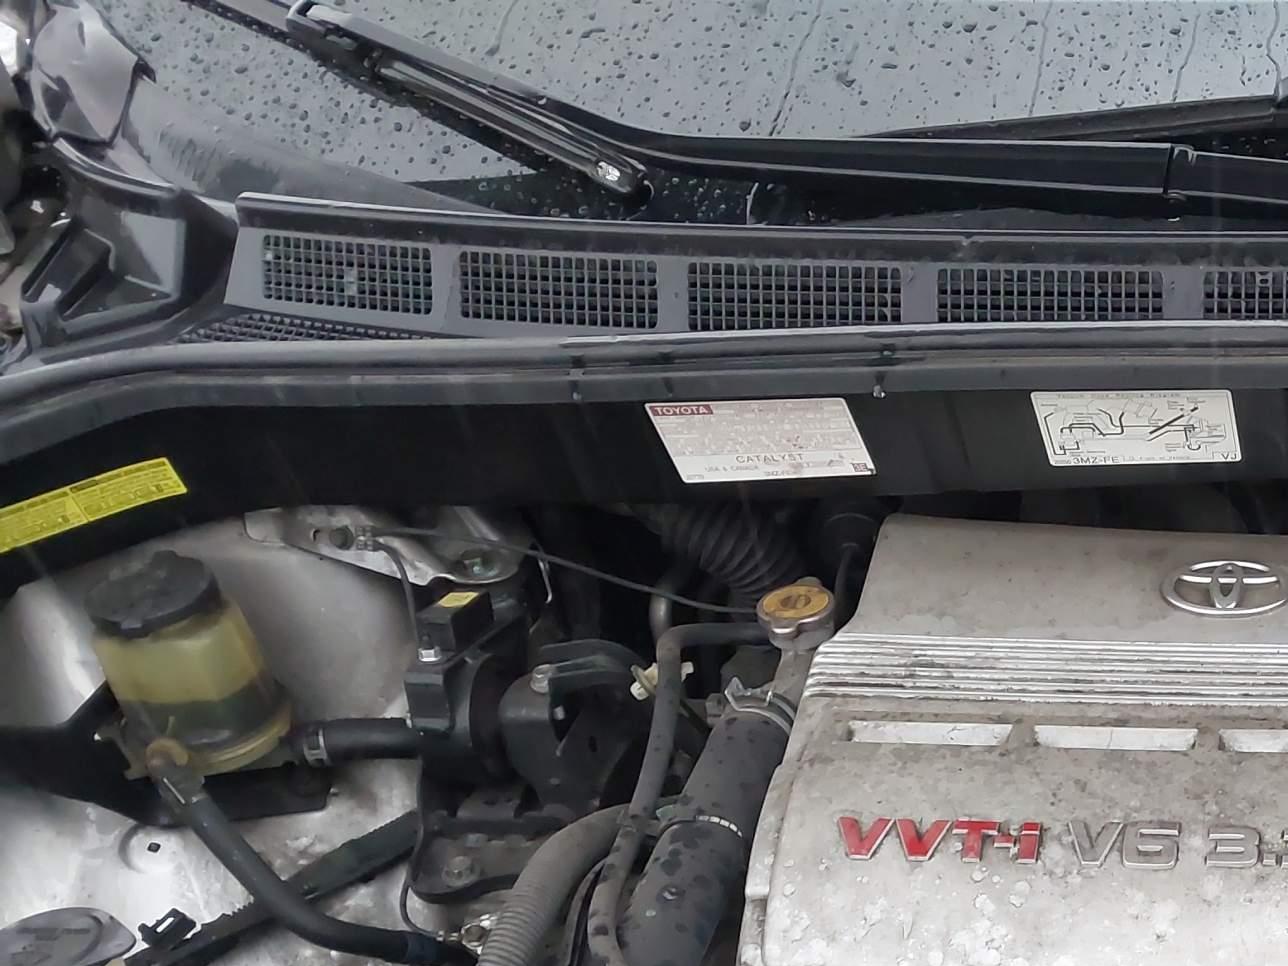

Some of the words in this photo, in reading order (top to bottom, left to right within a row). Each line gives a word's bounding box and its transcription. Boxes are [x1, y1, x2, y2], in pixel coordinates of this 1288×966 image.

[654, 405, 709, 416] TOYOTA
[735, 453, 804, 465] CATALYST
[1072, 456, 1120, 465] 3MZ-FE
[1221, 452, 1238, 461] VJ
[1068, 820, 1182, 871] V6
